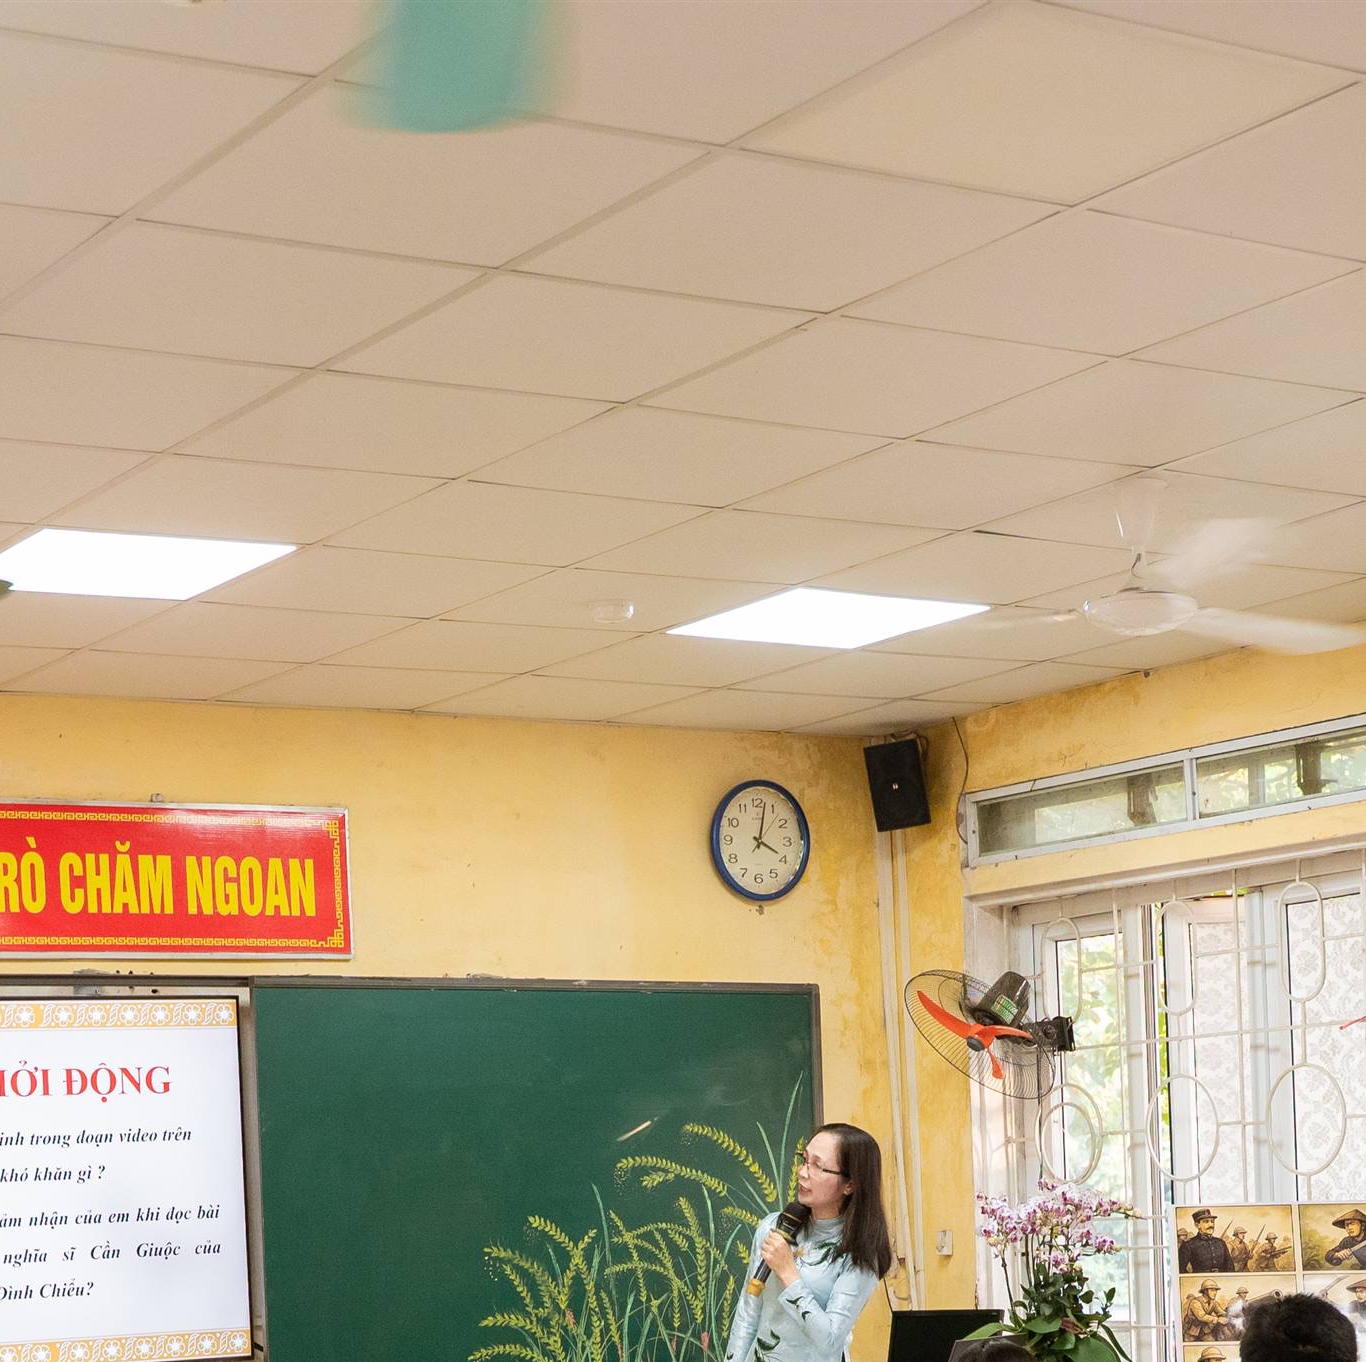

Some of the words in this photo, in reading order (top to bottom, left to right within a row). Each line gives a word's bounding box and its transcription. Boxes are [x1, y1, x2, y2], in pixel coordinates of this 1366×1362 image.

[738, 803, 747, 813] 11
[751, 797, 764, 809] 12
[771, 804, 775, 814] 1
[727, 817, 739, 828] 10
[778, 818, 788, 829] 2
[723, 834, 733, 845] 9
[782, 836, 792, 847] 3
[728, 853, 739, 864] 8
[778, 854, 788, 865] 4
[58, 840, 174, 915] CHĂM
[185, 855, 316, 917] NGOAN
[740, 868, 748, 878] 7
[754, 873, 764, 884] 6
[769, 868, 779, 879] 5
[63, 1063, 172, 1103] ĐỘNG
[29, 1133, 71, 1148] trong
[119, 1127, 158, 1143] video
[162, 1126, 192, 1142] trên
[0, 1167, 29, 1183] khó
[33, 1166, 72, 1182] khăn
[76, 1165, 92, 1184] gì
[28, 1211, 69, 1230] nhận
[108, 1212, 130, 1224] em
[135, 1206, 161, 1223] khi
[196, 1204, 220, 1220] bài
[3, 1248, 48, 1268] nghĩa
[63, 1246, 77, 1261] sĩ
[90, 1240, 121, 1260] Cần
[136, 1241, 181, 1261] Giuộc
